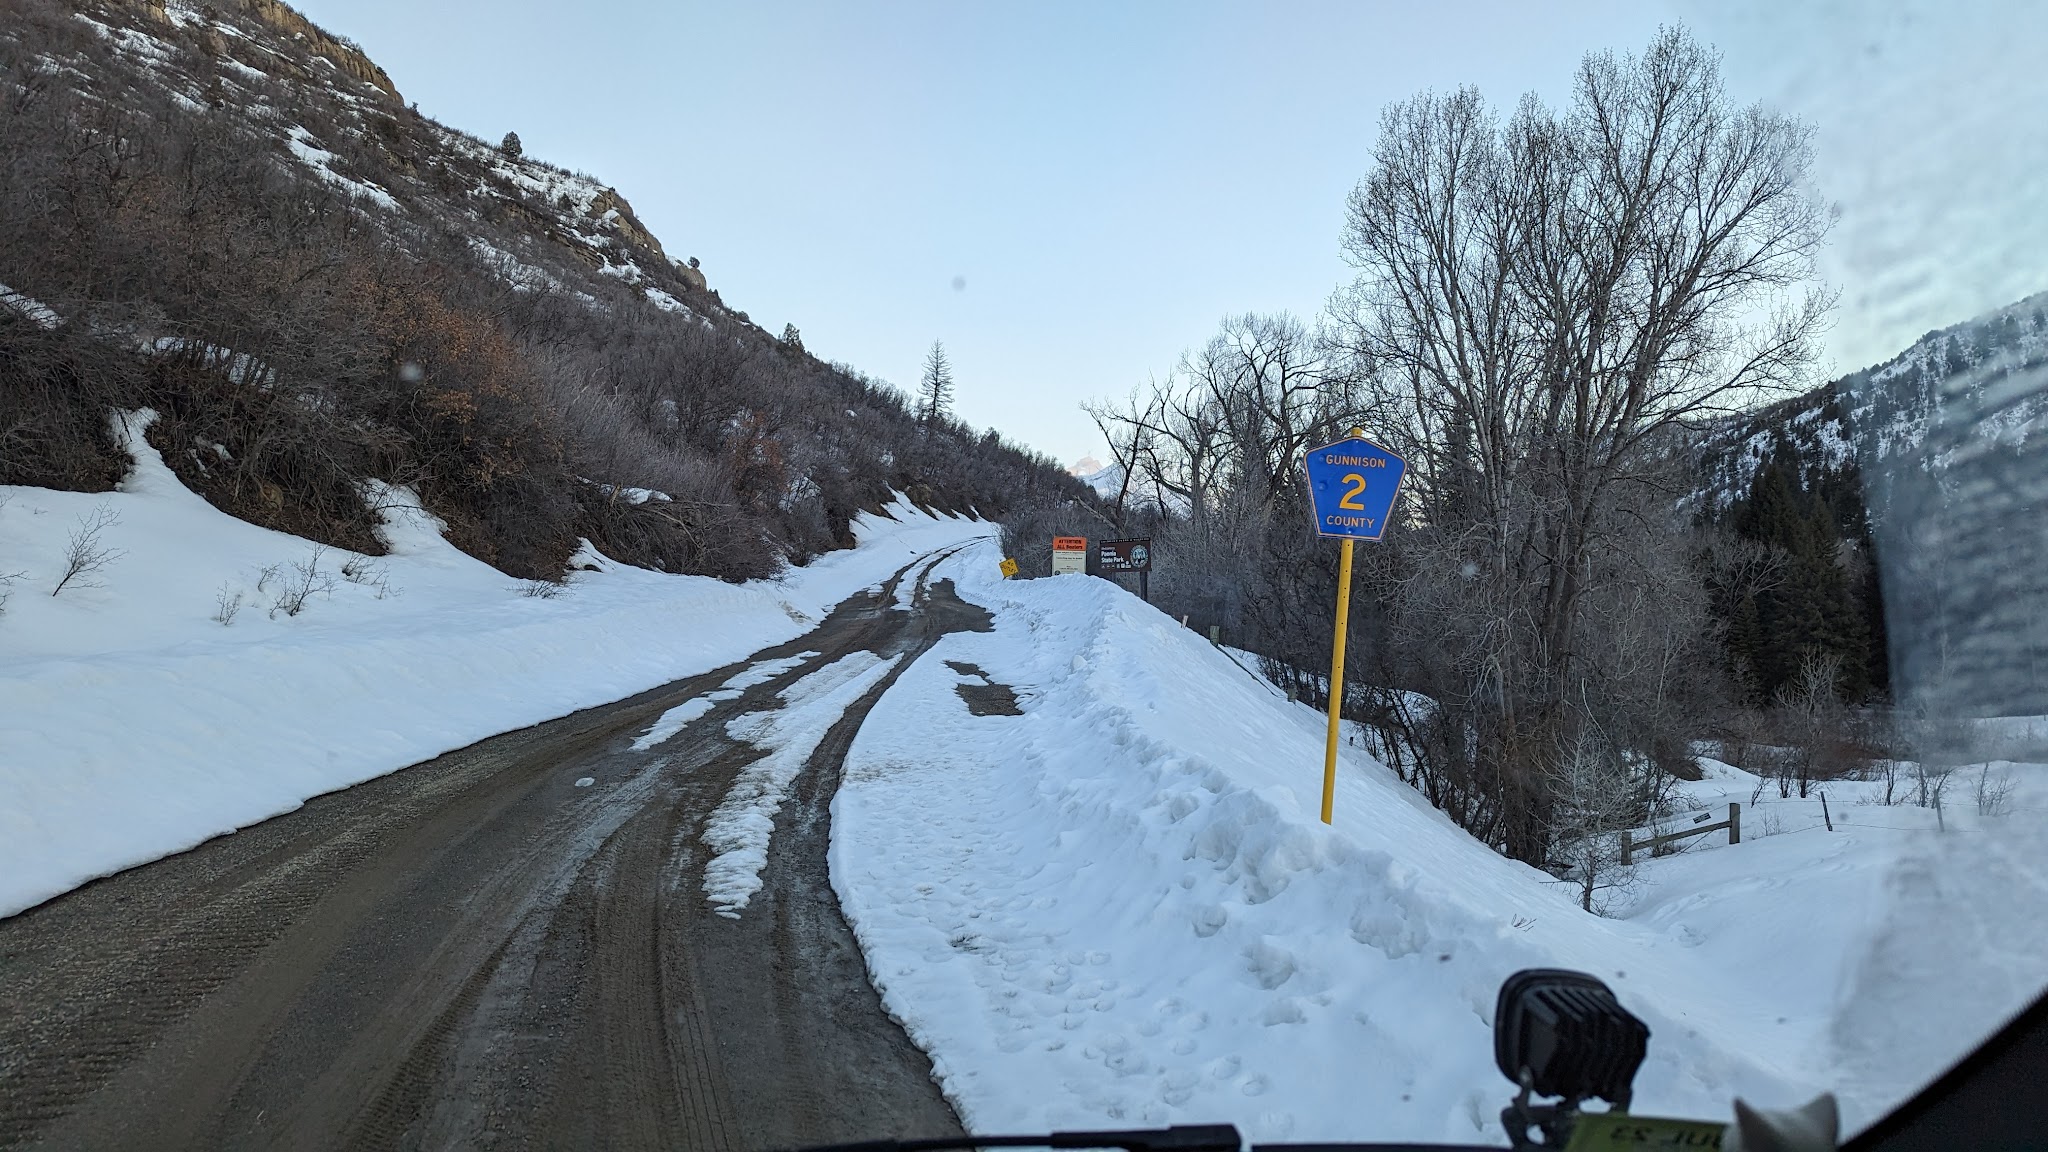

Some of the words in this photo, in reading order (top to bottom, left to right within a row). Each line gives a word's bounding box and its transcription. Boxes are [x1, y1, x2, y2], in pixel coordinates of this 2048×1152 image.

[1326, 454, 1386, 468] GUNNISON
[1339, 473, 1367, 511] 2
[1326, 515, 1375, 528] COUNTY
[1001, 564, 1016, 573] OUTLET
